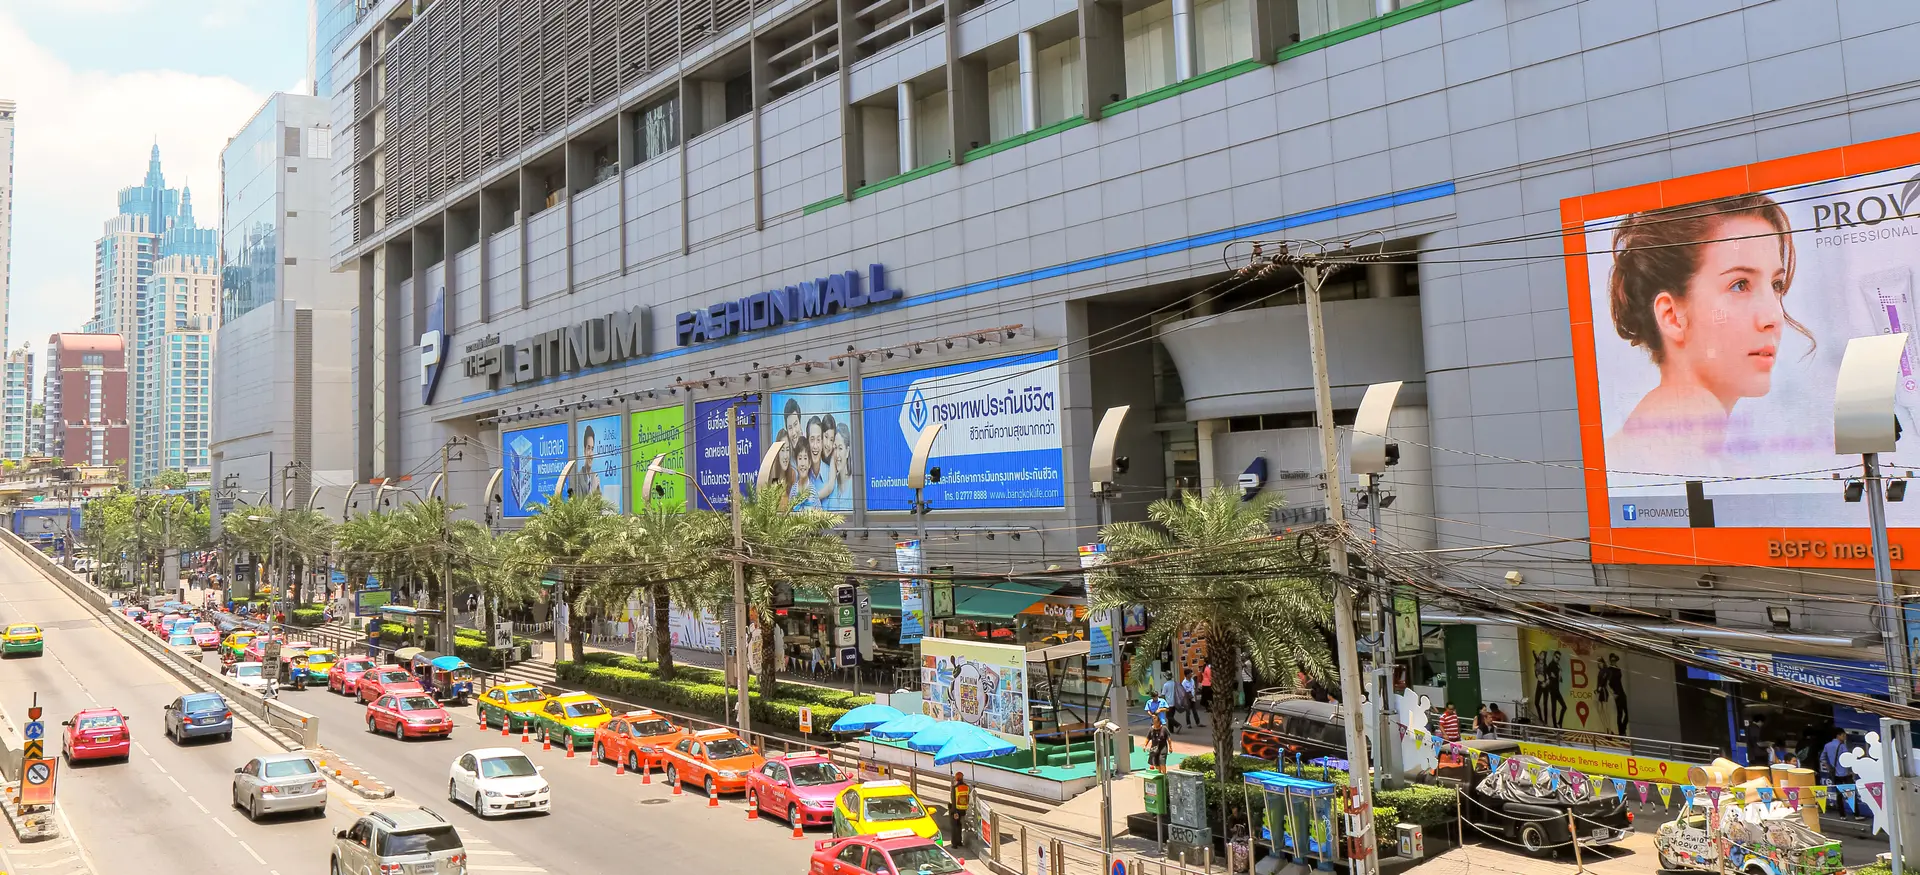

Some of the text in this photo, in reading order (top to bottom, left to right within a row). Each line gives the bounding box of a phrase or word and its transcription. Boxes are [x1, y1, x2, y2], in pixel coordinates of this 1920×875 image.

[1812, 192, 1920, 233] PROV
[1815, 225, 1919, 248] PROFESSIONAL
[461, 263, 903, 390] THE PLATINUM FASHION MALL
[932, 386, 1055, 429] กรุงเทพประกันชีวิต
[969, 419, 1056, 441] ชีวิตที่มีความสุขมากกว่า
[960, 490, 972, 500] 2777
[990, 487, 1059, 501] www.bangkoklife.com
[1768, 540, 1904, 561] BGFC mea
[1569, 658, 1589, 689] B
[1775, 662, 1805, 673] MONEY
[1773, 671, 1842, 688] EXCHANGE
[1569, 691, 1593, 700] FLOOR
[1537, 750, 1543, 759] &
[1543, 750, 1576, 764] Fabulous
[1578, 756, 1599, 767] Items
[1601, 759, 1619, 769] Here
[1626, 758, 1639, 777] B
[1639, 765, 1656, 773] FLOOR
